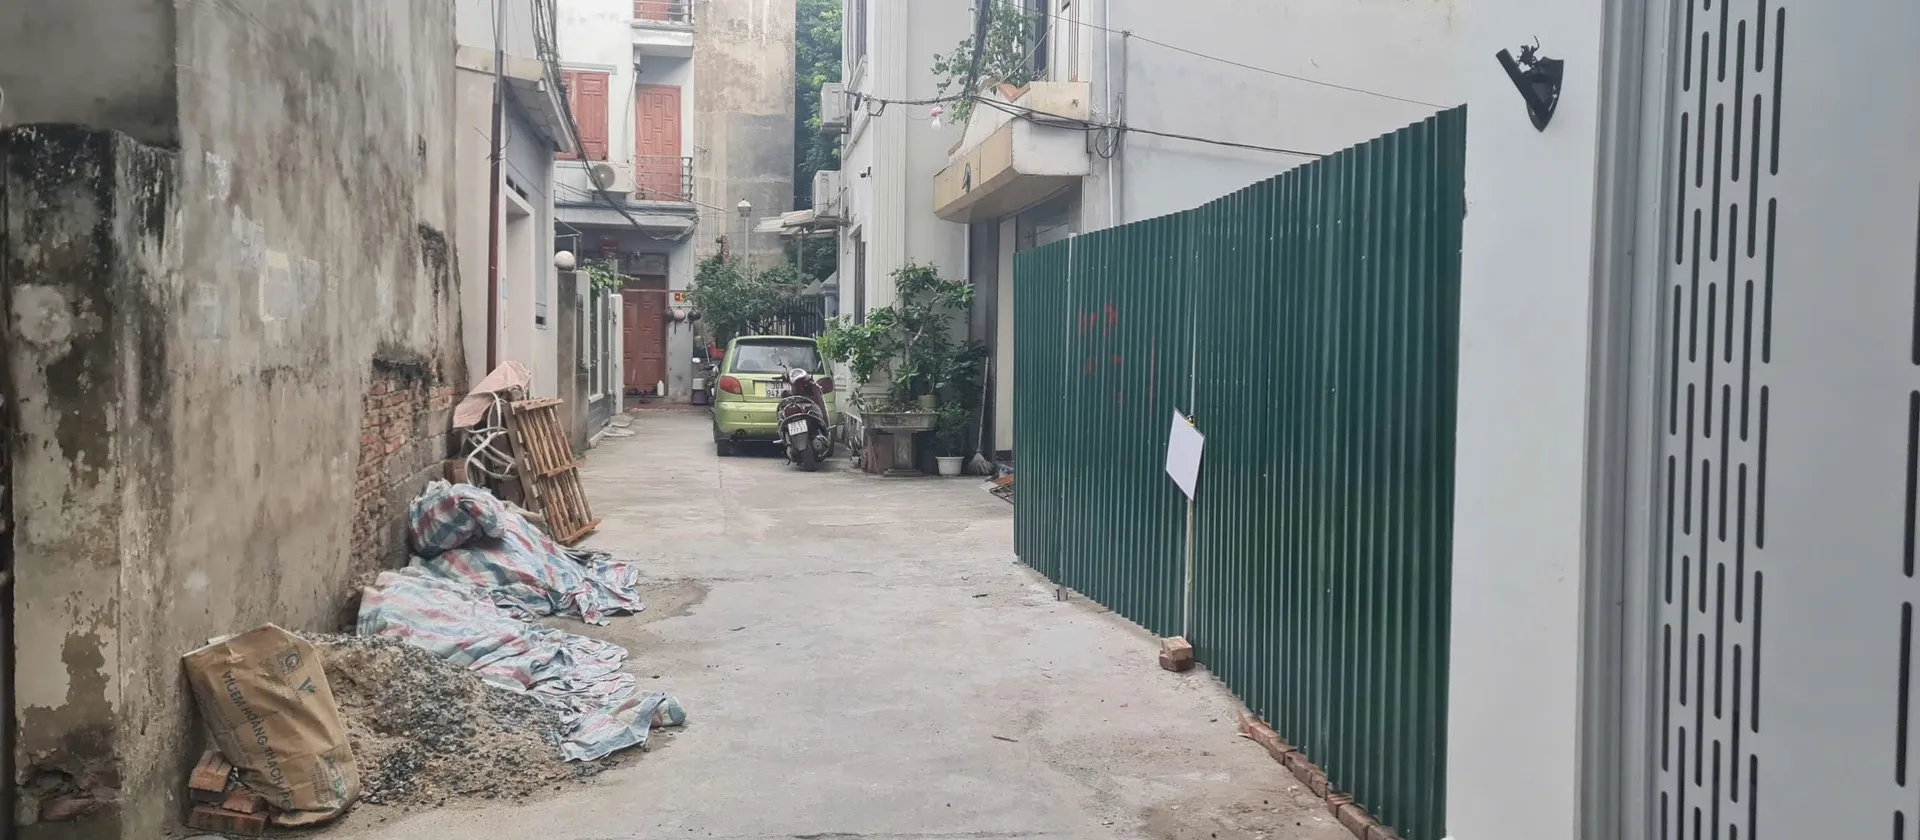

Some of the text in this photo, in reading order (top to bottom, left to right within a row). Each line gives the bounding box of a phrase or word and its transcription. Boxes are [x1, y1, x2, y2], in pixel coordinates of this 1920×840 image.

[221, 671, 243, 707] VICEM
[242, 704, 269, 747] HOÀNG
[263, 746, 287, 791] THẠCH
